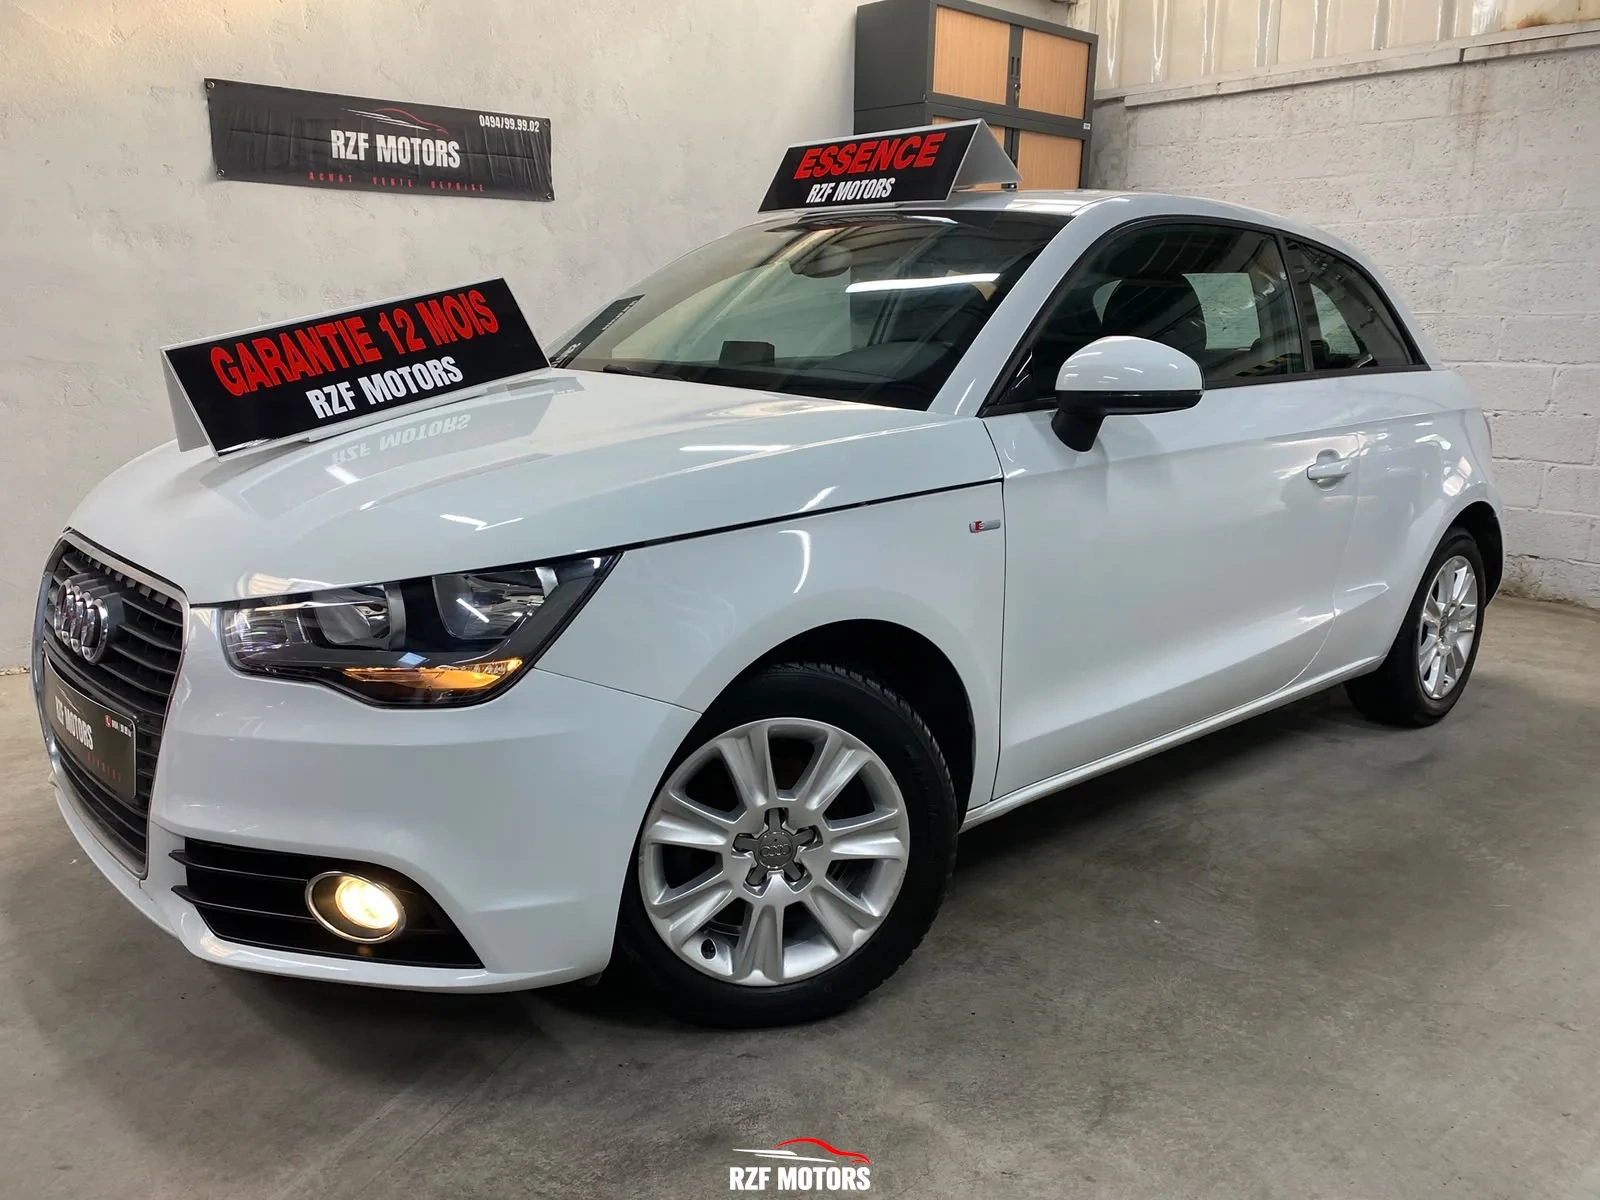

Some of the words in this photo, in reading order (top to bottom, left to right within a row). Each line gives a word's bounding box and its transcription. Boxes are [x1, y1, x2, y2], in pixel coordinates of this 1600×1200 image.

[479, 114, 540, 133] 0494/99.99.02
[330, 130, 370, 160] RZF
[376, 134, 461, 168] MOTORS
[793, 133, 946, 179] ESSENCE
[806, 184, 836, 204] RZF
[834, 178, 895, 202] MOTORS
[210, 315, 383, 397] GARANTIE
[379, 308, 427, 354] 12
[414, 289, 499, 347] MOIS
[305, 385, 356, 420] RZF
[358, 356, 463, 405] MOTORS
